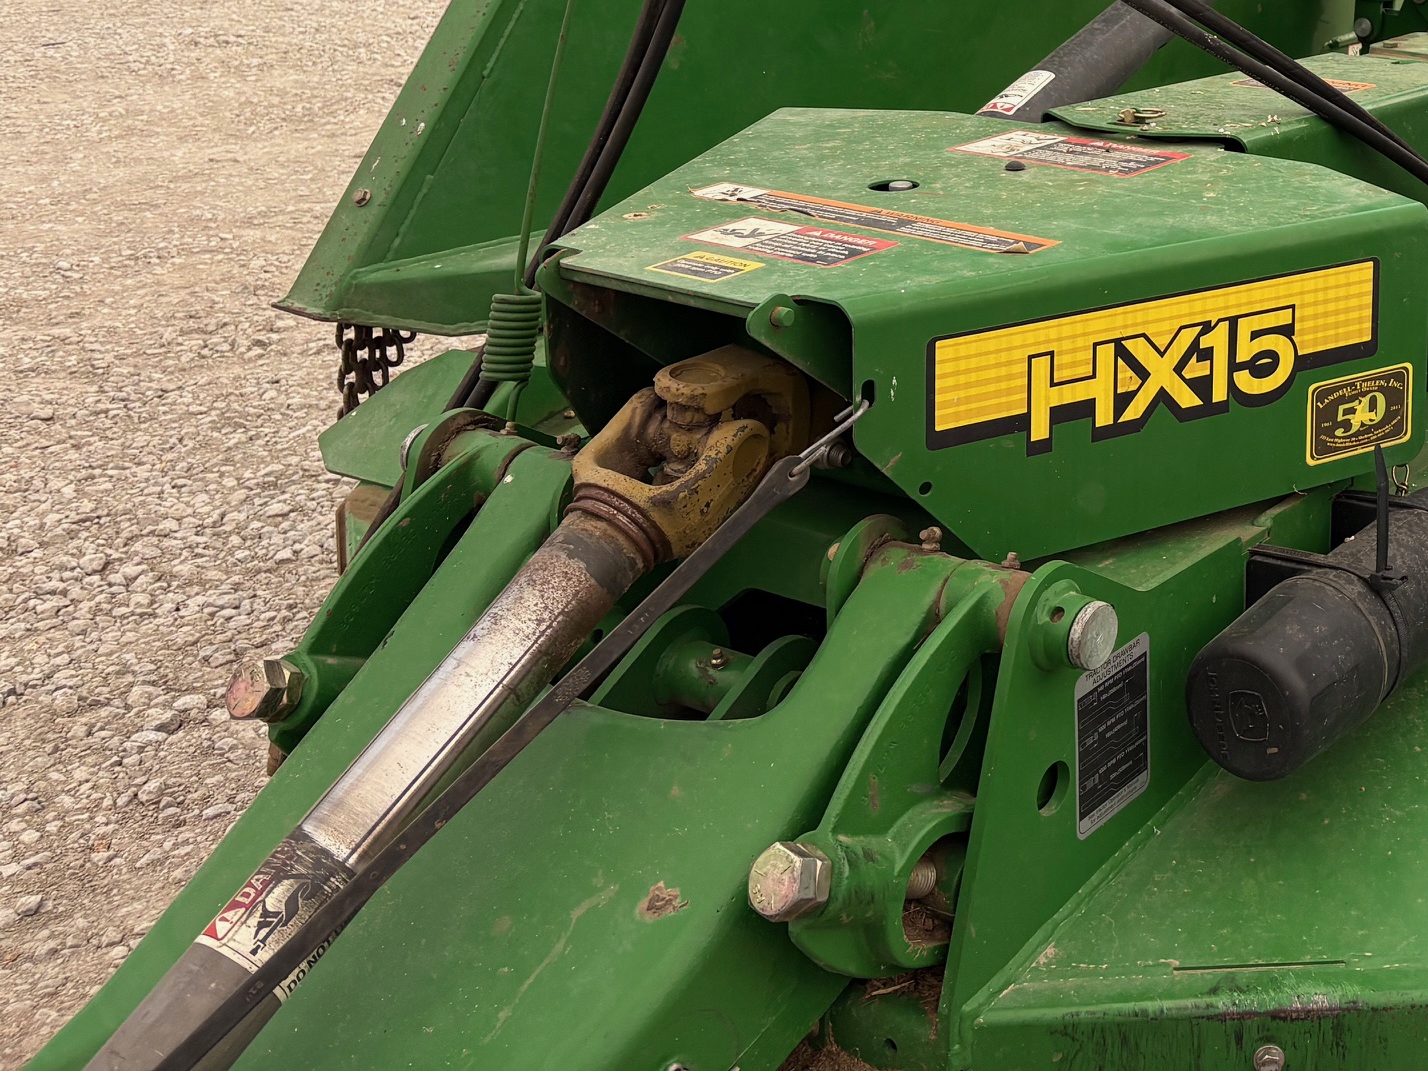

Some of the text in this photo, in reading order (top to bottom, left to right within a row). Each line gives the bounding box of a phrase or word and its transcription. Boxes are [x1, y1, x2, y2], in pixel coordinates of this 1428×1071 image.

[824, 232, 878, 246] DANGER
[704, 255, 751, 267] CAUTION
[1029, 305, 1297, 445] HX15
[1317, 379, 1387, 409] LANDELL-THELEN,
[1334, 391, 1386, 437] 50
[1085, 658, 1112, 682] TRACTOR
[1112, 638, 1140, 663] DRAWBAR
[1092, 652, 1134, 686] ADJUSTMENTS
[286, 967, 306, 994] DO
